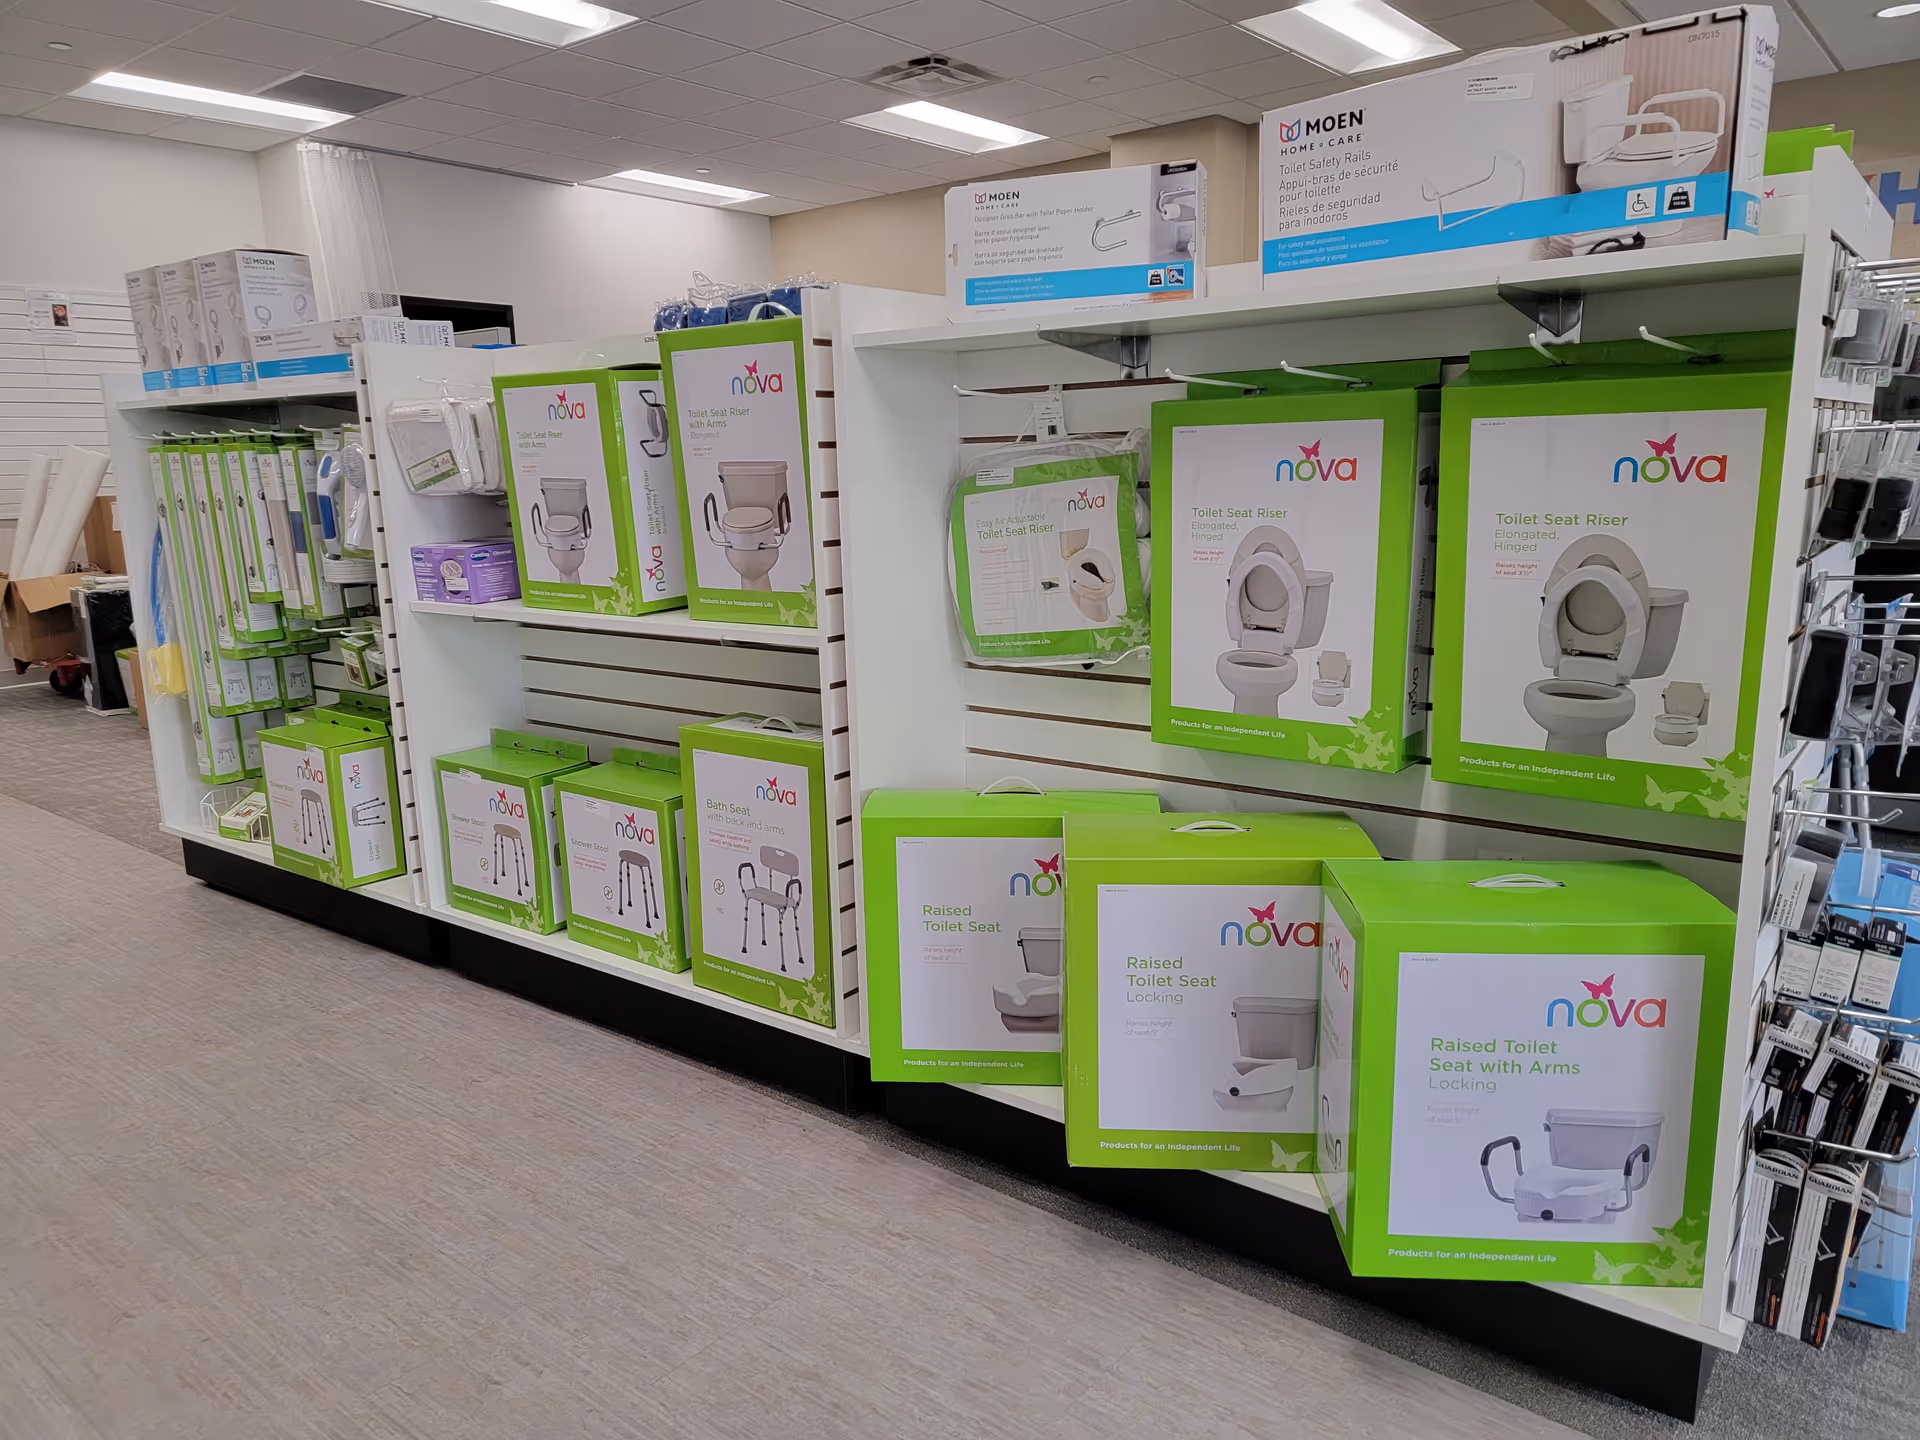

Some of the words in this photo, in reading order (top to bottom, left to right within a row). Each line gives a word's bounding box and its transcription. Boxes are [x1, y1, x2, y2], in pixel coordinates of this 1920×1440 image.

[1305, 109, 1364, 136] MOEN
[1280, 142, 1315, 156] HOME
[1328, 133, 1362, 147] CARE
[1280, 162, 1306, 175] Toilet
[1309, 156, 1342, 170] Safety
[1345, 150, 1371, 164] Rails
[1279, 172, 1335, 192] Appui-bras
[1339, 170, 1351, 180] de
[1354, 159, 1399, 178] sécurité
[989, 191, 1020, 202] MOEN
[1280, 192, 1302, 205] pour
[1305, 185, 1341, 198] toilette
[1040, 209, 1054, 217] Toilet
[1056, 208, 1072, 216] Paper
[1280, 205, 1309, 217] Rieles
[1312, 202, 1325, 213] de
[1328, 192, 1381, 211] seguridad
[1279, 220, 1300, 232] para
[1304, 212, 1348, 226] inodoros
[732, 373, 783, 395] nova
[548, 401, 586, 420] nova
[688, 409, 708, 418] Toilet
[711, 408, 728, 417] Seat
[730, 407, 750, 416] Riser
[689, 420, 704, 428] with
[707, 419, 727, 428] Arms
[517, 431, 533, 440] Toilet
[548, 431, 562, 439] Riser
[1275, 457, 1357, 482] nova
[1613, 455, 1728, 483] nova
[1068, 495, 1105, 512] nova
[976, 519, 993, 529] Easy
[1007, 513, 1046, 525] Adjustable
[1192, 508, 1223, 518] Toilet
[1227, 508, 1253, 518] Seat
[1257, 508, 1288, 519] Riser
[1496, 513, 1539, 525] Toilet
[1544, 513, 1580, 526] Seat
[1586, 514, 1629, 526] Riser
[977, 529, 1003, 540] Toilet
[1005, 526, 1027, 537] Seat
[1029, 524, 1054, 534] Riser
[1191, 522, 1239, 532] Elongated,
[1494, 529, 1560, 541] Elongated,
[1191, 532, 1223, 541] Hinged
[1494, 542, 1537, 553] Hinged
[651, 545, 666, 592] nova
[1170, 718, 1200, 729] Products
[1201, 721, 1213, 730] for
[1224, 725, 1270, 738] Independent
[1271, 730, 1286, 739] Life
[297, 765, 324, 784] nova
[1459, 756, 1500, 768] Products
[1502, 760, 1516, 770] for
[1518, 763, 1530, 771] an
[1532, 765, 1594, 779] Independent
[1597, 772, 1616, 782] Life
[756, 785, 796, 806] nova
[489, 798, 525, 819] nova
[706, 799, 728, 812] Bath
[729, 804, 751, 816] Seat
[707, 813, 724, 822] with
[726, 815, 745, 827] back
[747, 820, 761, 830] and
[765, 824, 785, 835] arms
[615, 821, 655, 845] nova
[571, 837, 593, 849] Shower
[593, 843, 609, 853] Stool
[922, 905, 972, 916] Raised
[923, 920, 963, 932] Toilet
[968, 921, 1001, 933] Seat
[1220, 921, 1324, 947] nova
[1127, 956, 1183, 970] Raised
[1328, 942, 1349, 992] nova
[1127, 975, 1173, 987] Toilet
[1179, 975, 1217, 987] Seat
[1126, 992, 1183, 1004] Locking
[1819, 991, 1839, 1001] drive
[1861, 997, 1881, 1005] drive
[1546, 998, 1667, 1028] nova
[1431, 1037, 1497, 1053] Raised
[1504, 1040, 1558, 1055] Toilet
[1768, 1035, 1810, 1055] GUARDIAN
[903, 1059, 936, 1067] Products
[1429, 1058, 1473, 1072] Seat
[1480, 1060, 1522, 1074] with
[1528, 1061, 1581, 1075] Arms
[1829, 1047, 1871, 1070] GUARDIAN
[1429, 1077, 1497, 1094] Locking
[1167, 1143, 1222, 1152] Independent
[1224, 1144, 1241, 1152] Life
[1755, 1160, 1799, 1180] GUARDIAN
[1809, 1176, 1853, 1195] GUARDIAN
[1389, 1248, 1433, 1258] Products
[1436, 1250, 1451, 1259] for
[1469, 1253, 1534, 1263] Independent
[1538, 1254, 1557, 1263] Life
